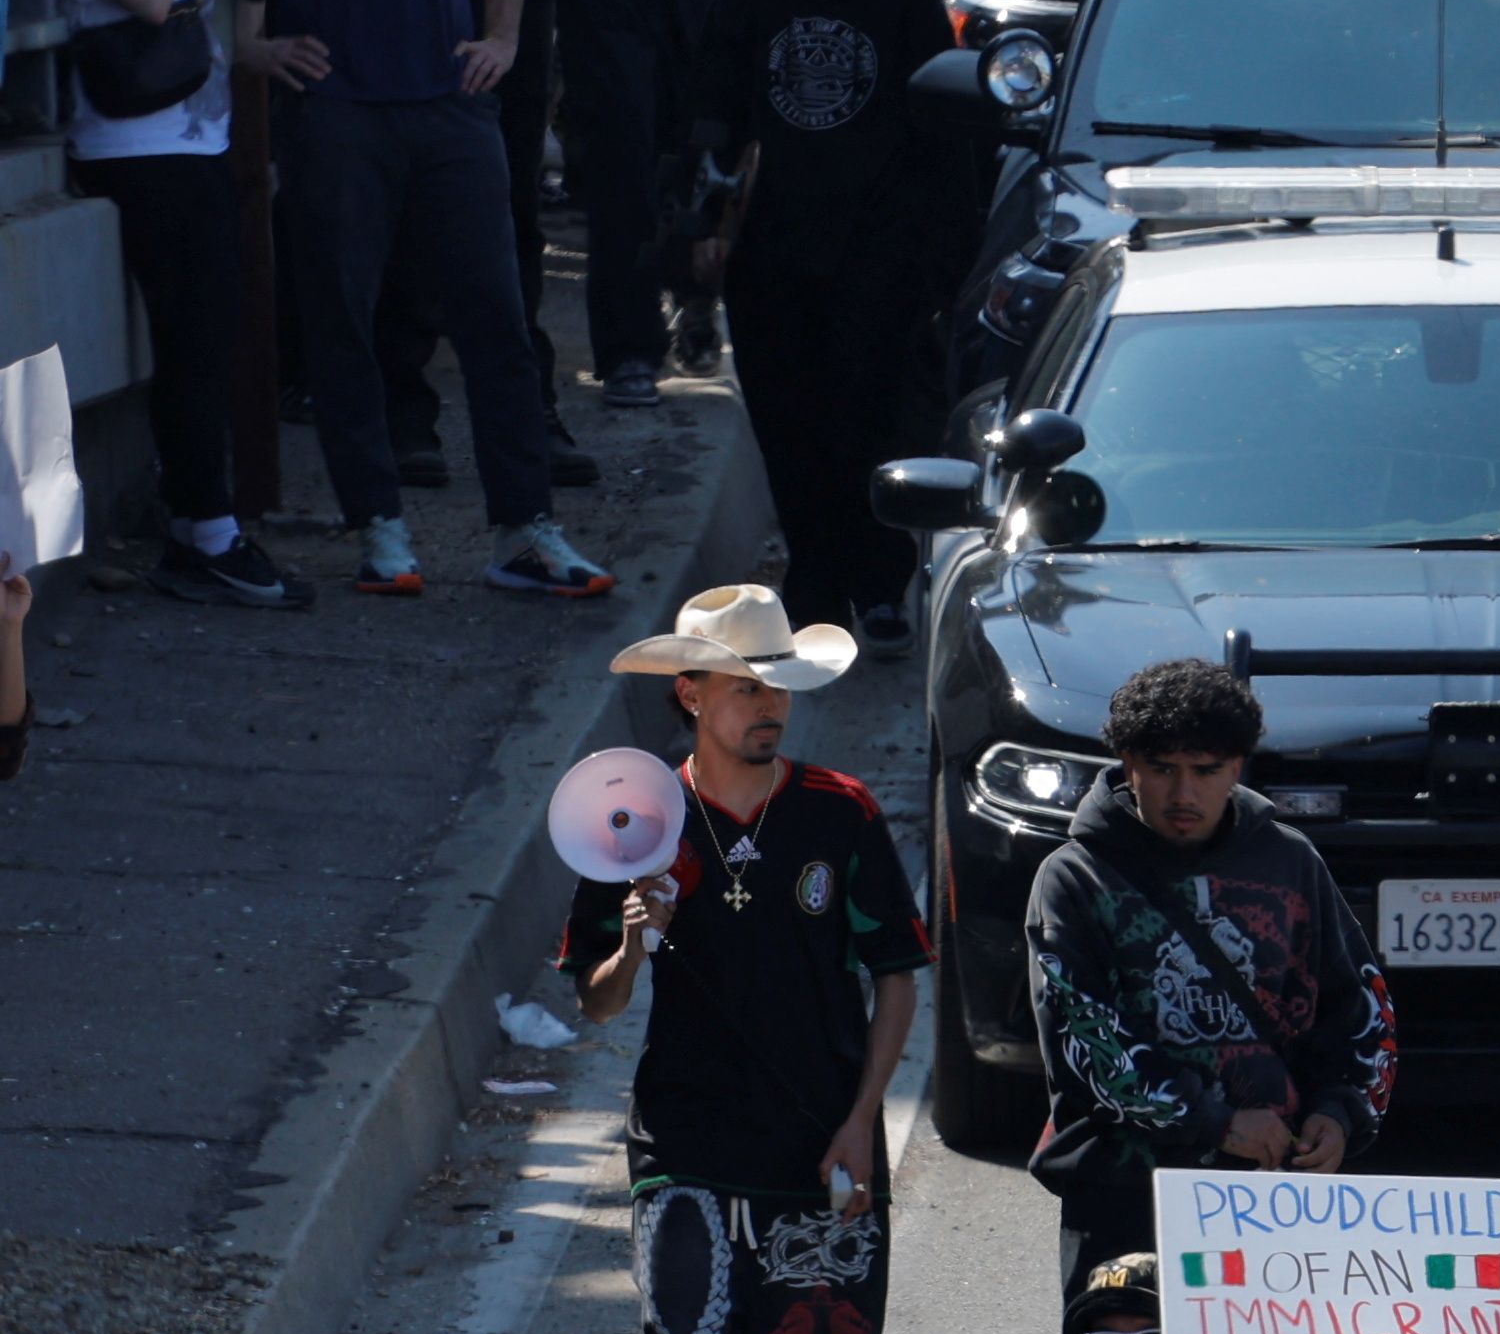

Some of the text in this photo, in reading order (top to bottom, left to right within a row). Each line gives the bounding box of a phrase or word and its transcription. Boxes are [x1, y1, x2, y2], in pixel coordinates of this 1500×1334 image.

[1422, 890, 1446, 903] CA
[1195, 1180, 1360, 1238] PROUD
[1260, 1249, 1416, 1297] OF AN
